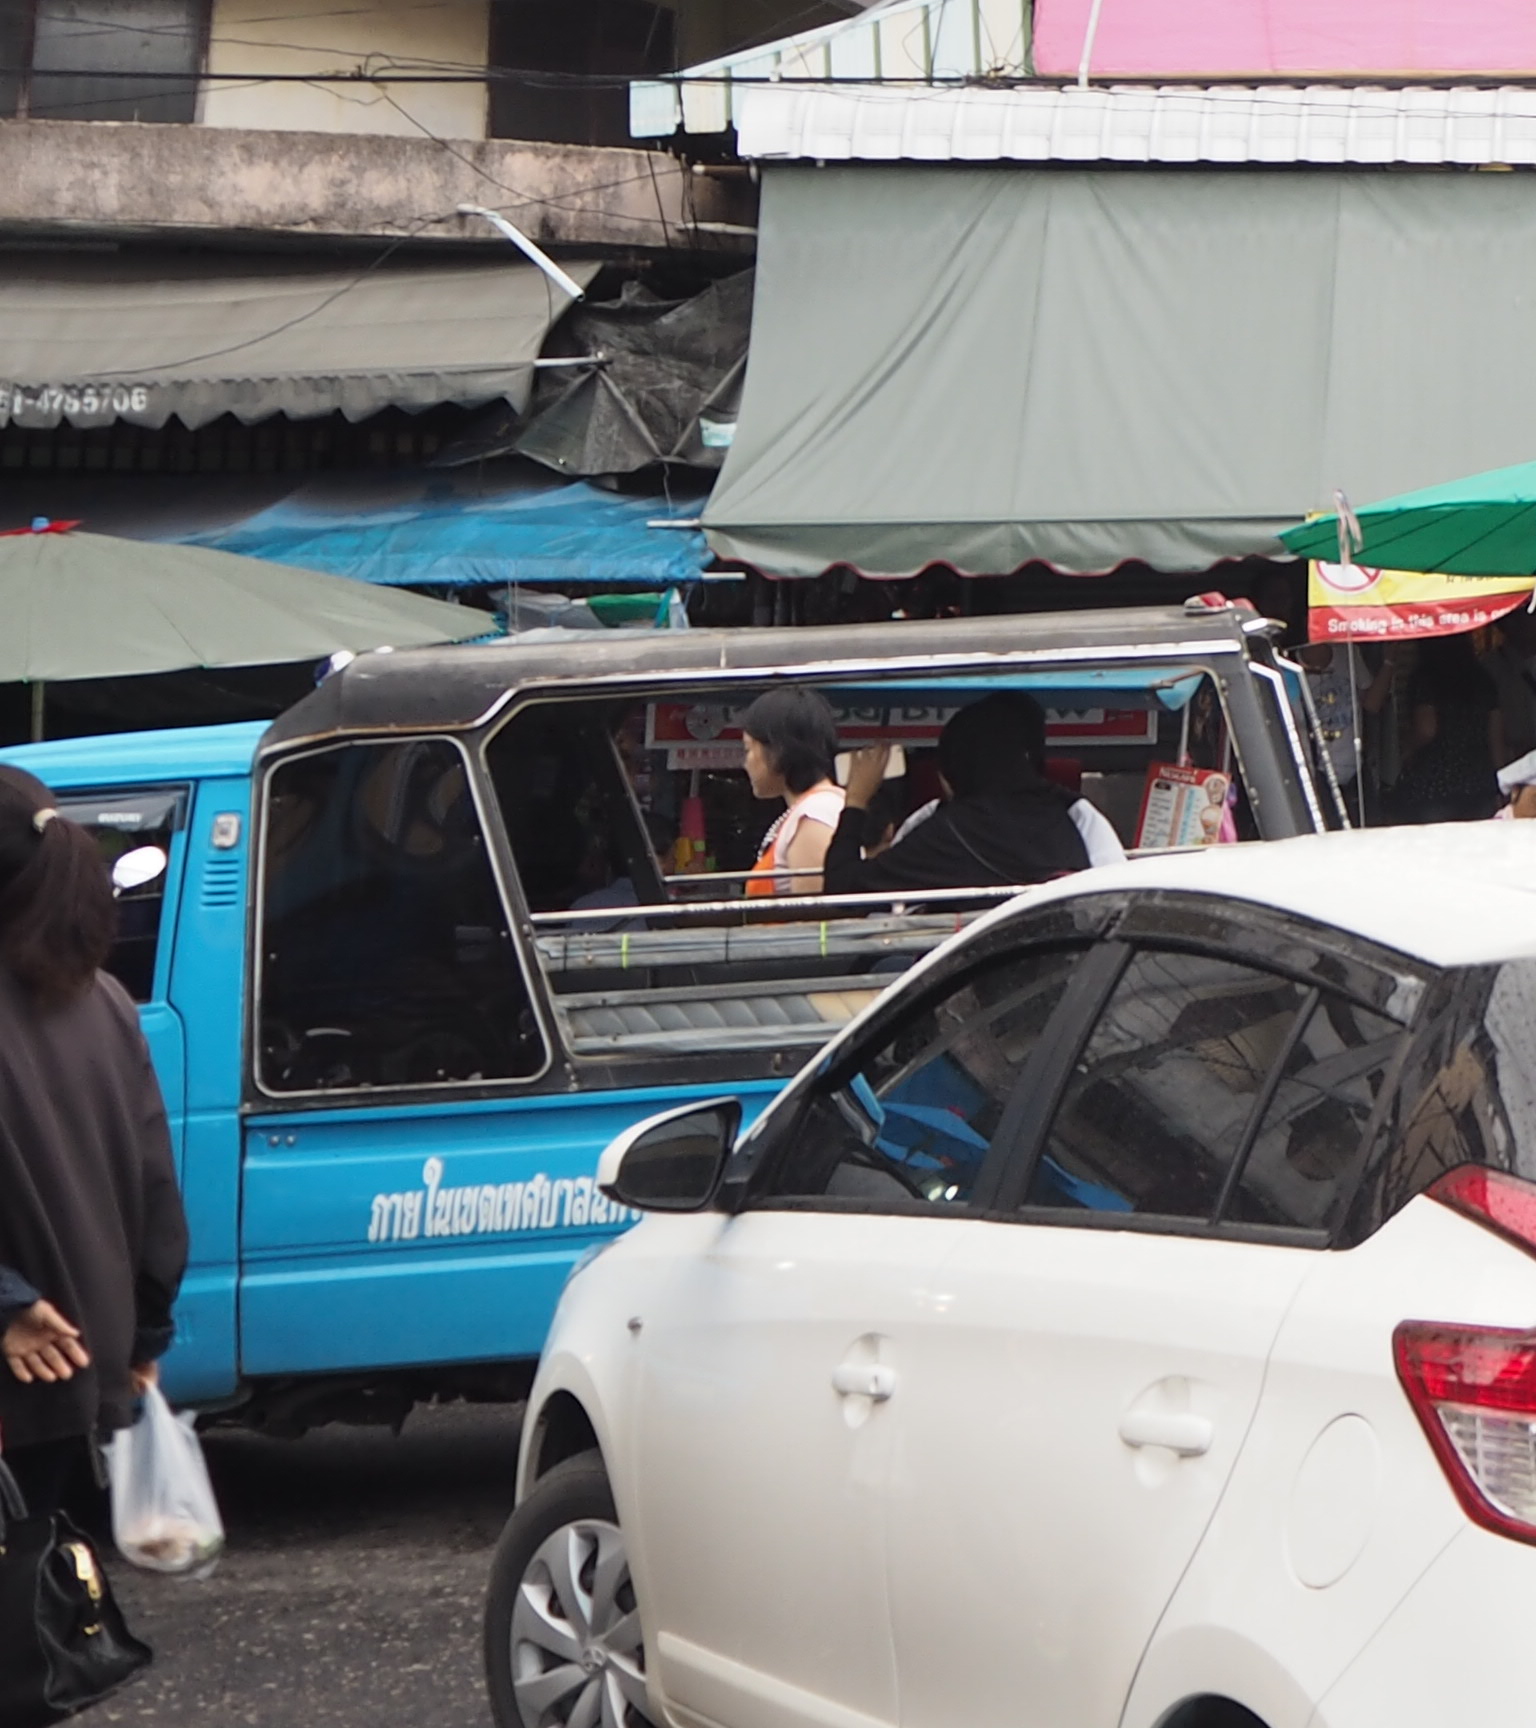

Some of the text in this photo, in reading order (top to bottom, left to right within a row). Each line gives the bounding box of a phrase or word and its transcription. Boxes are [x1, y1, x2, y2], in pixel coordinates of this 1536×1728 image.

[1327, 617, 1388, 635] Smoking
[1408, 613, 1435, 629] this
[1439, 612, 1470, 626] area
[1473, 608, 1487, 623] is
